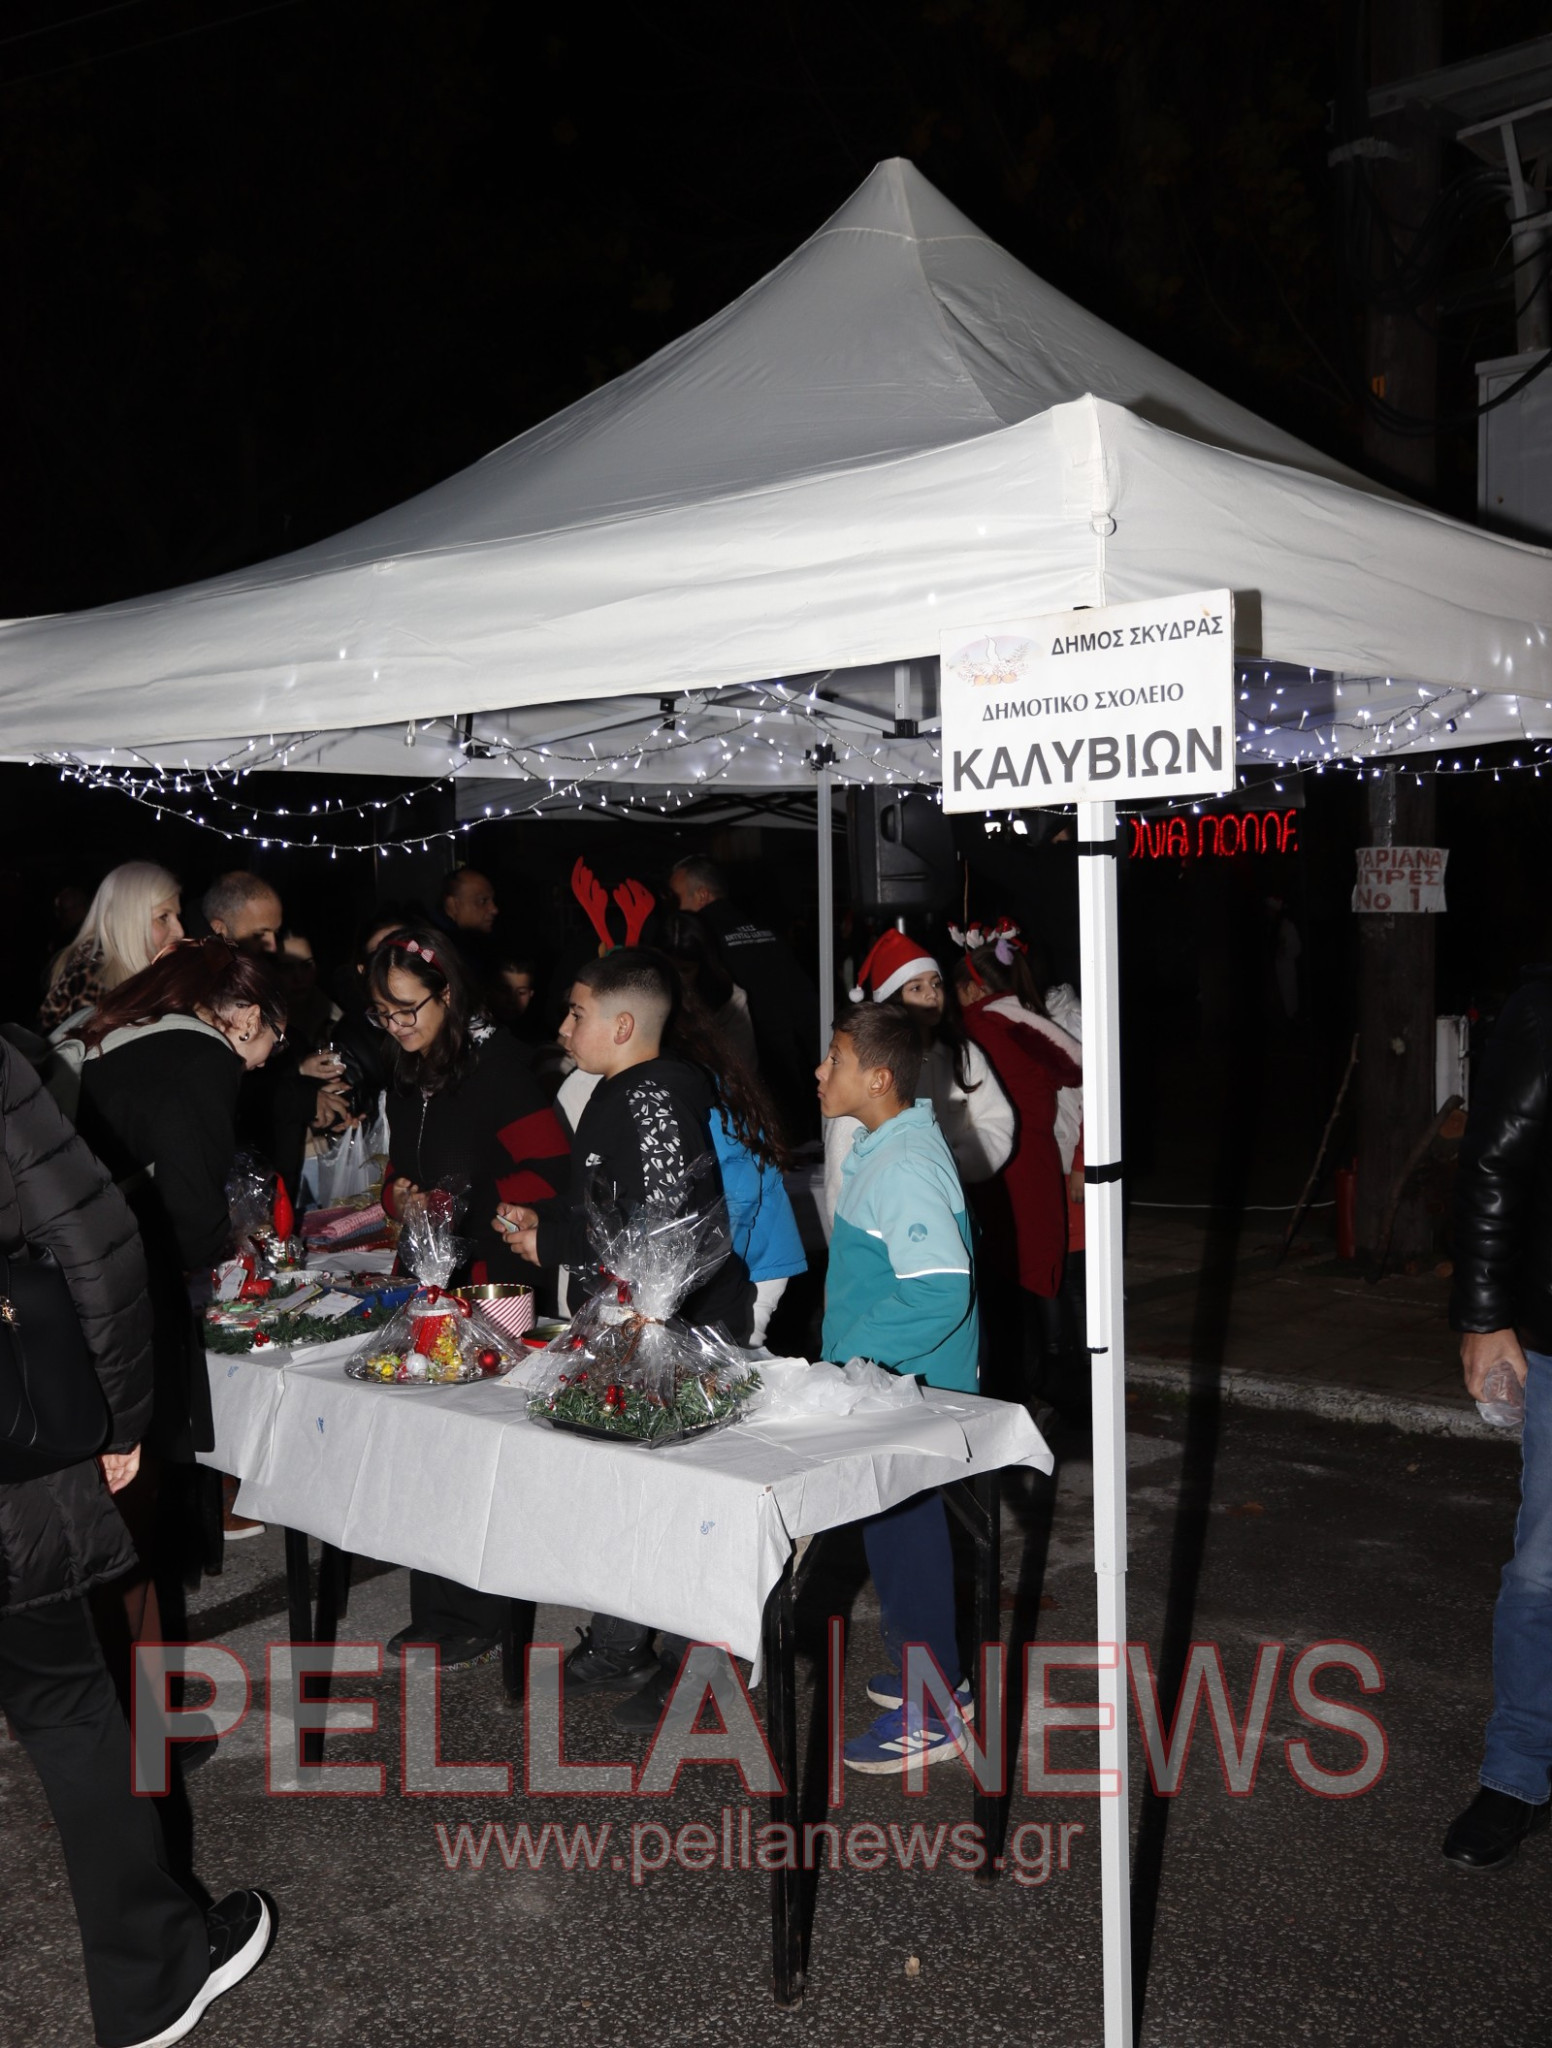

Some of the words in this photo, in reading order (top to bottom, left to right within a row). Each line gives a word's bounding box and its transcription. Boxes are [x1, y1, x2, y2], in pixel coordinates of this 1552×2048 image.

[1051, 630, 1124, 656] ΔΗΜΟΣ
[1130, 615, 1224, 646] ΣΚΥΔΡΑΣ
[982, 693, 1089, 722] ΔΗΜΟΤΙΚΟ
[1094, 682, 1185, 710] ΣΧΟΛΕΙΟ
[953, 725, 1223, 792] ΚΑΛΥΒΙΩΝ
[1409, 888, 1421, 911] 1
